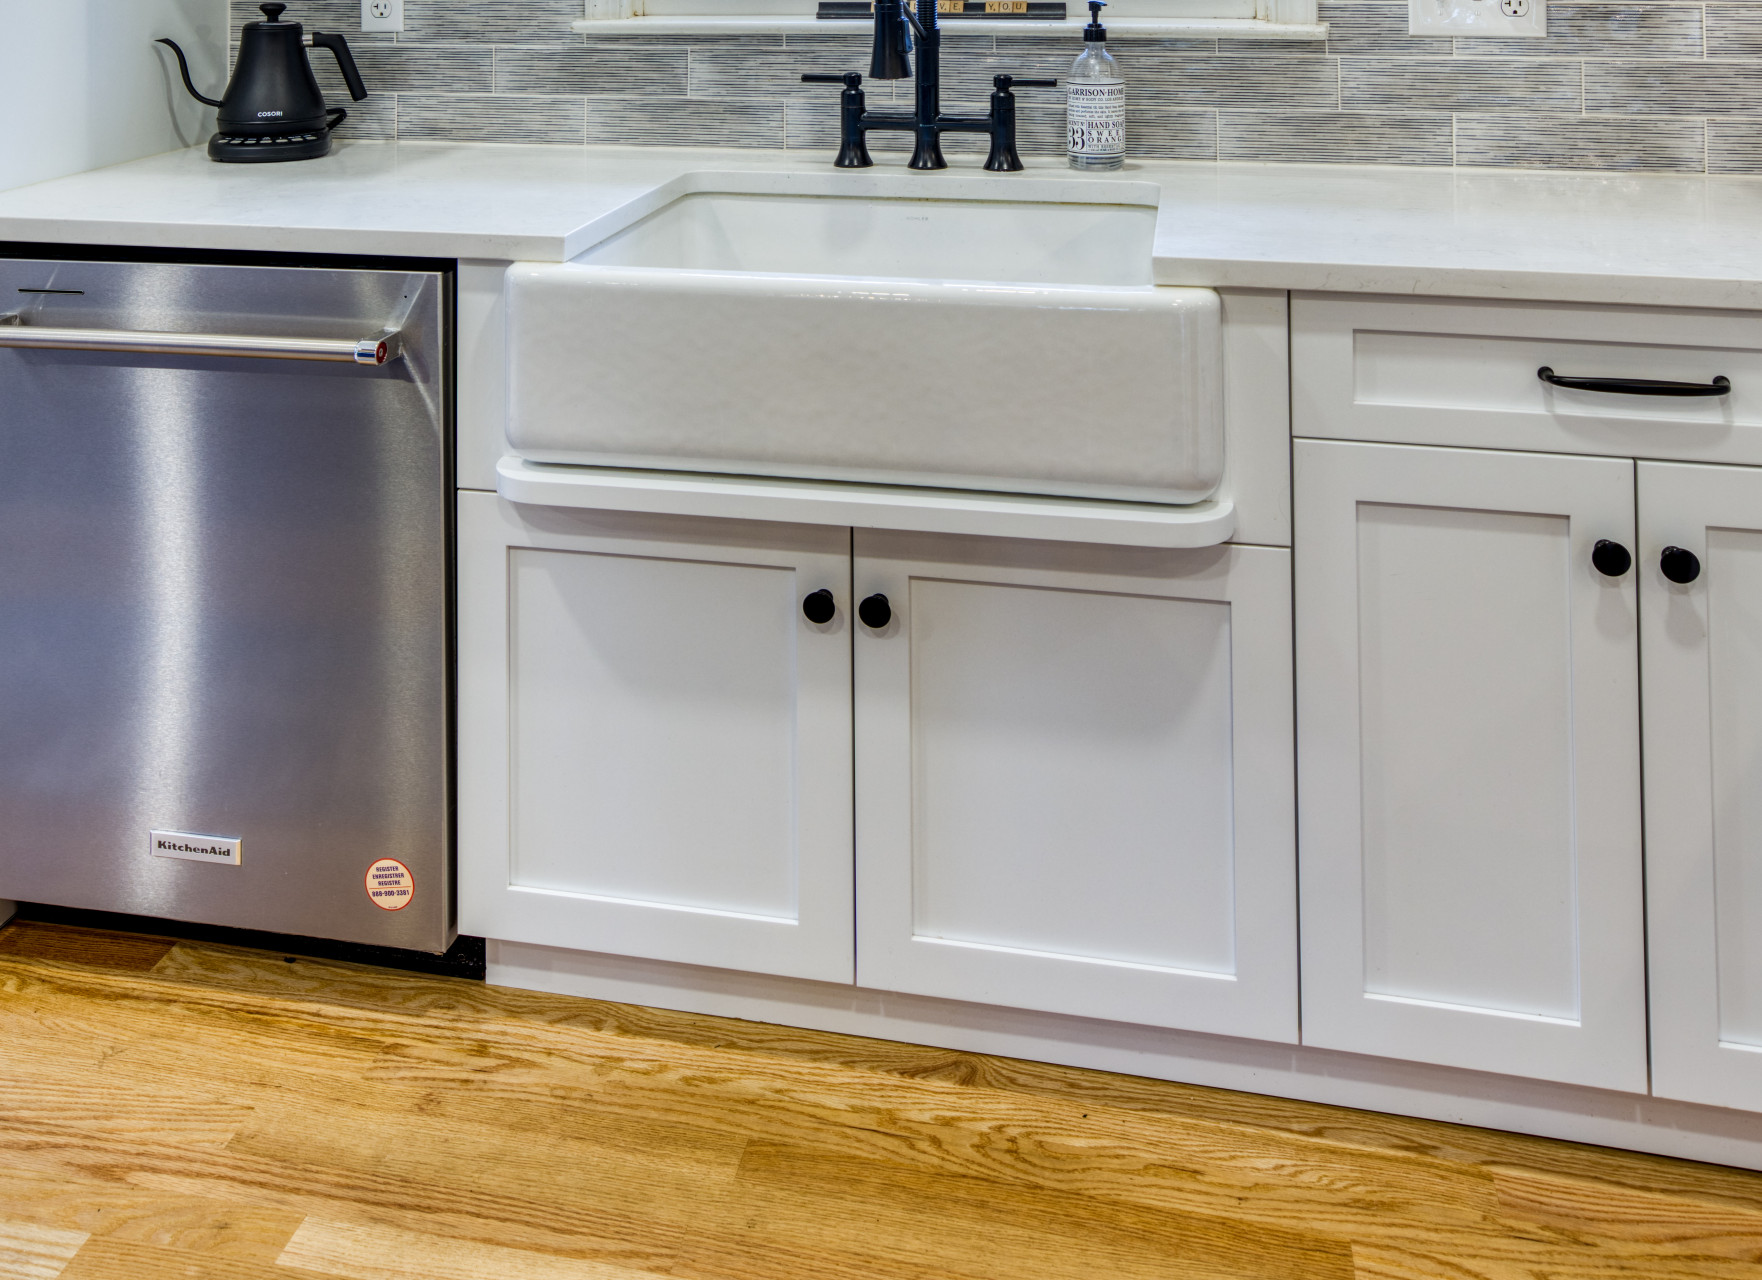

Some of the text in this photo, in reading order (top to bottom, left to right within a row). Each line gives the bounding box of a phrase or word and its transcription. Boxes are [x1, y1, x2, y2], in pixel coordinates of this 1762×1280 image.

[988, 2, 1022, 11] YOU
[257, 110, 283, 118] COSORI
[1087, 121, 1111, 129] HAND
[1068, 125, 1086, 150] 33
[157, 840, 231, 856] KitchenAid
